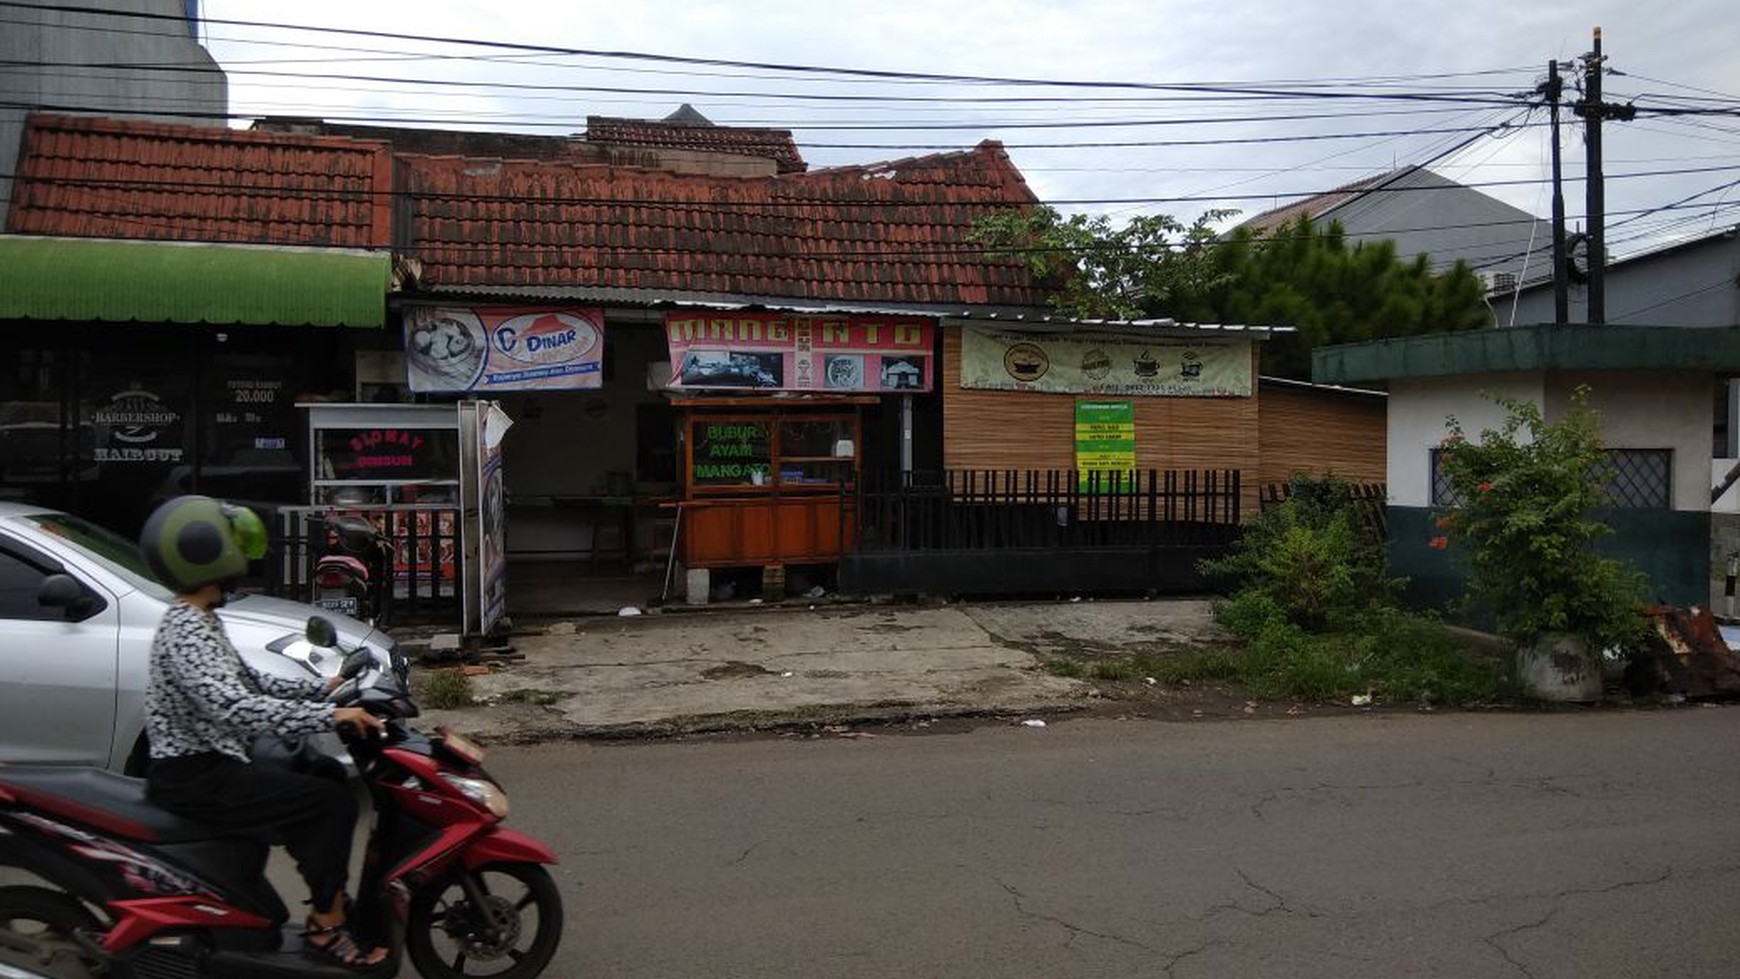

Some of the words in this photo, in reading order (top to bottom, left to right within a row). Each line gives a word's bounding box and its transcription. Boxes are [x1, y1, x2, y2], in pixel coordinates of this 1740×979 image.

[526, 329, 577, 352] DINAR
[235, 389, 274, 403] 20.000
[708, 426, 757, 440] BUBUR
[93, 447, 184, 462] HAIRCUT
[710, 444, 753, 457] AYAM
[695, 464, 742, 478] MANG
